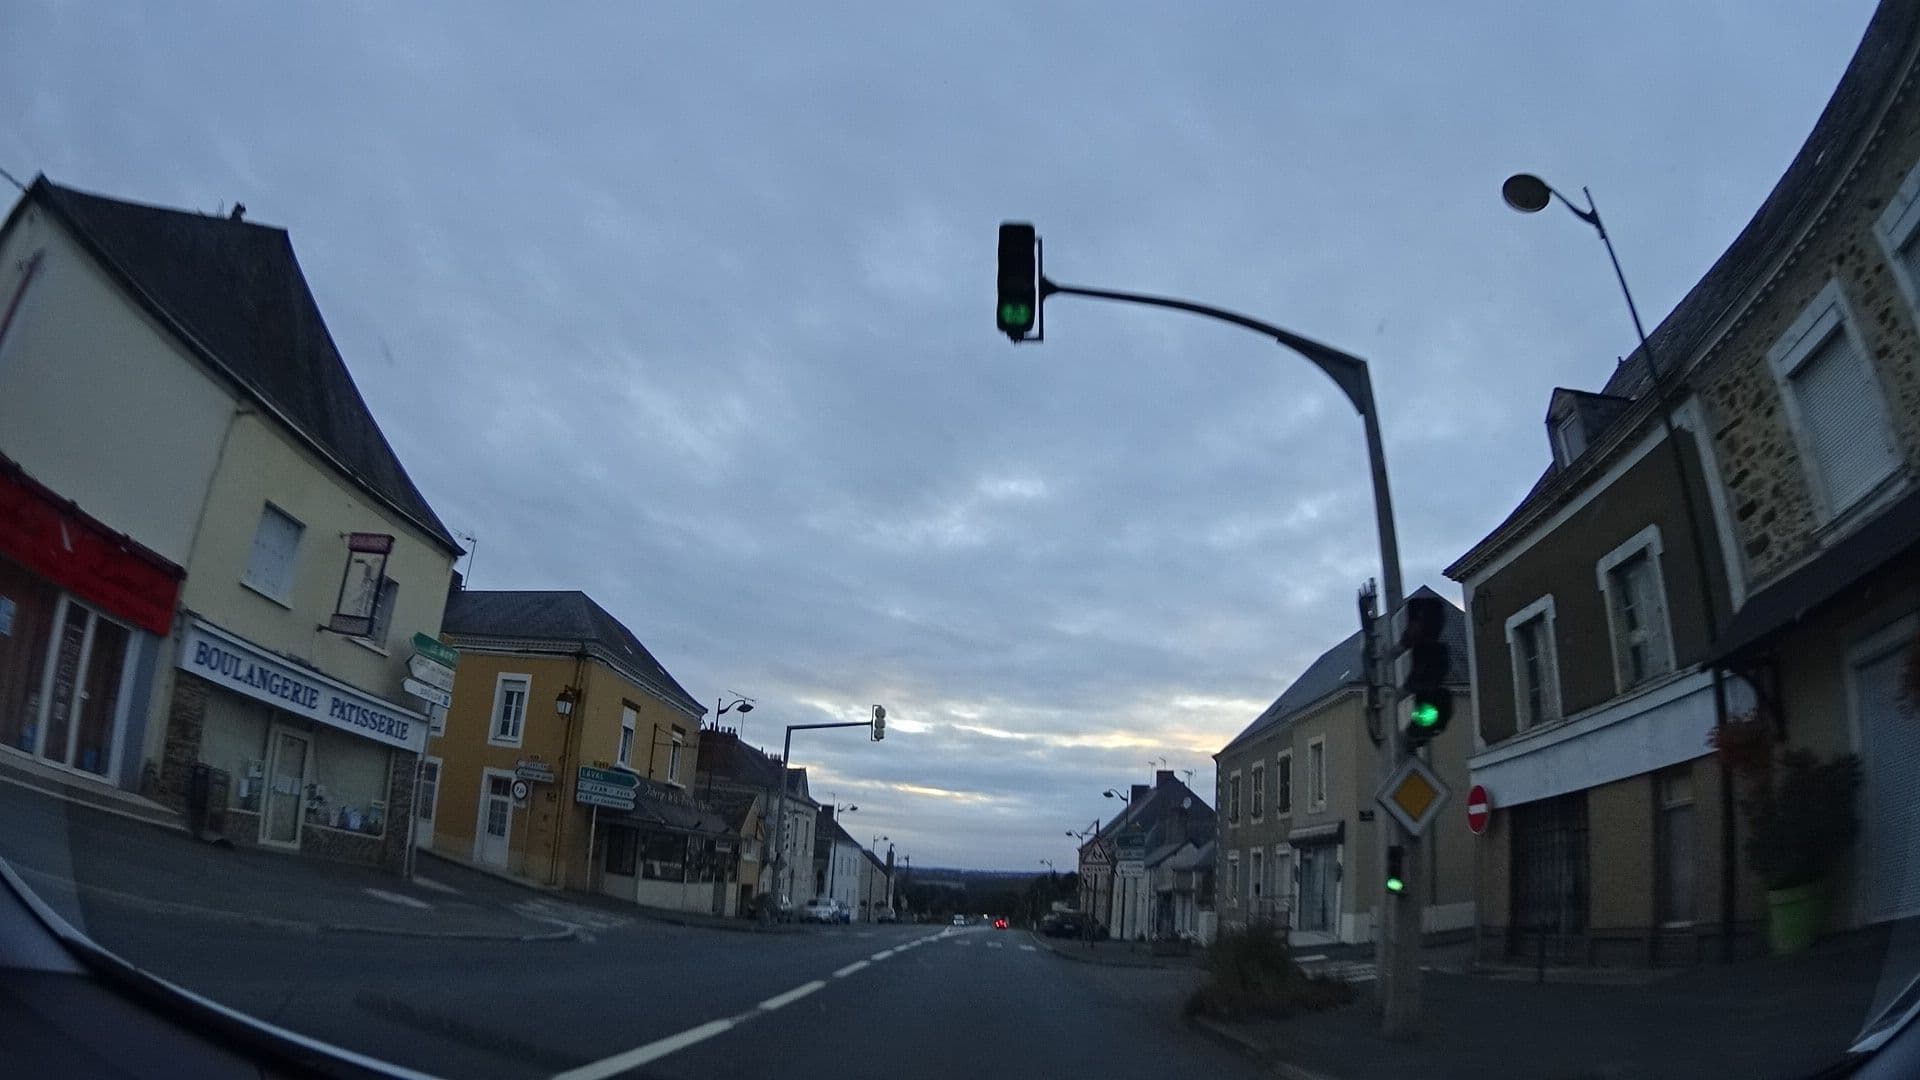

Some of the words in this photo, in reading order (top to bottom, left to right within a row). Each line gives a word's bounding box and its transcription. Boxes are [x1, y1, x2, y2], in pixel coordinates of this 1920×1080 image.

[194, 640, 320, 710] BOULANGERIE
[328, 697, 409, 741] PATISSERIE
[582, 769, 604, 780] LAVAL
